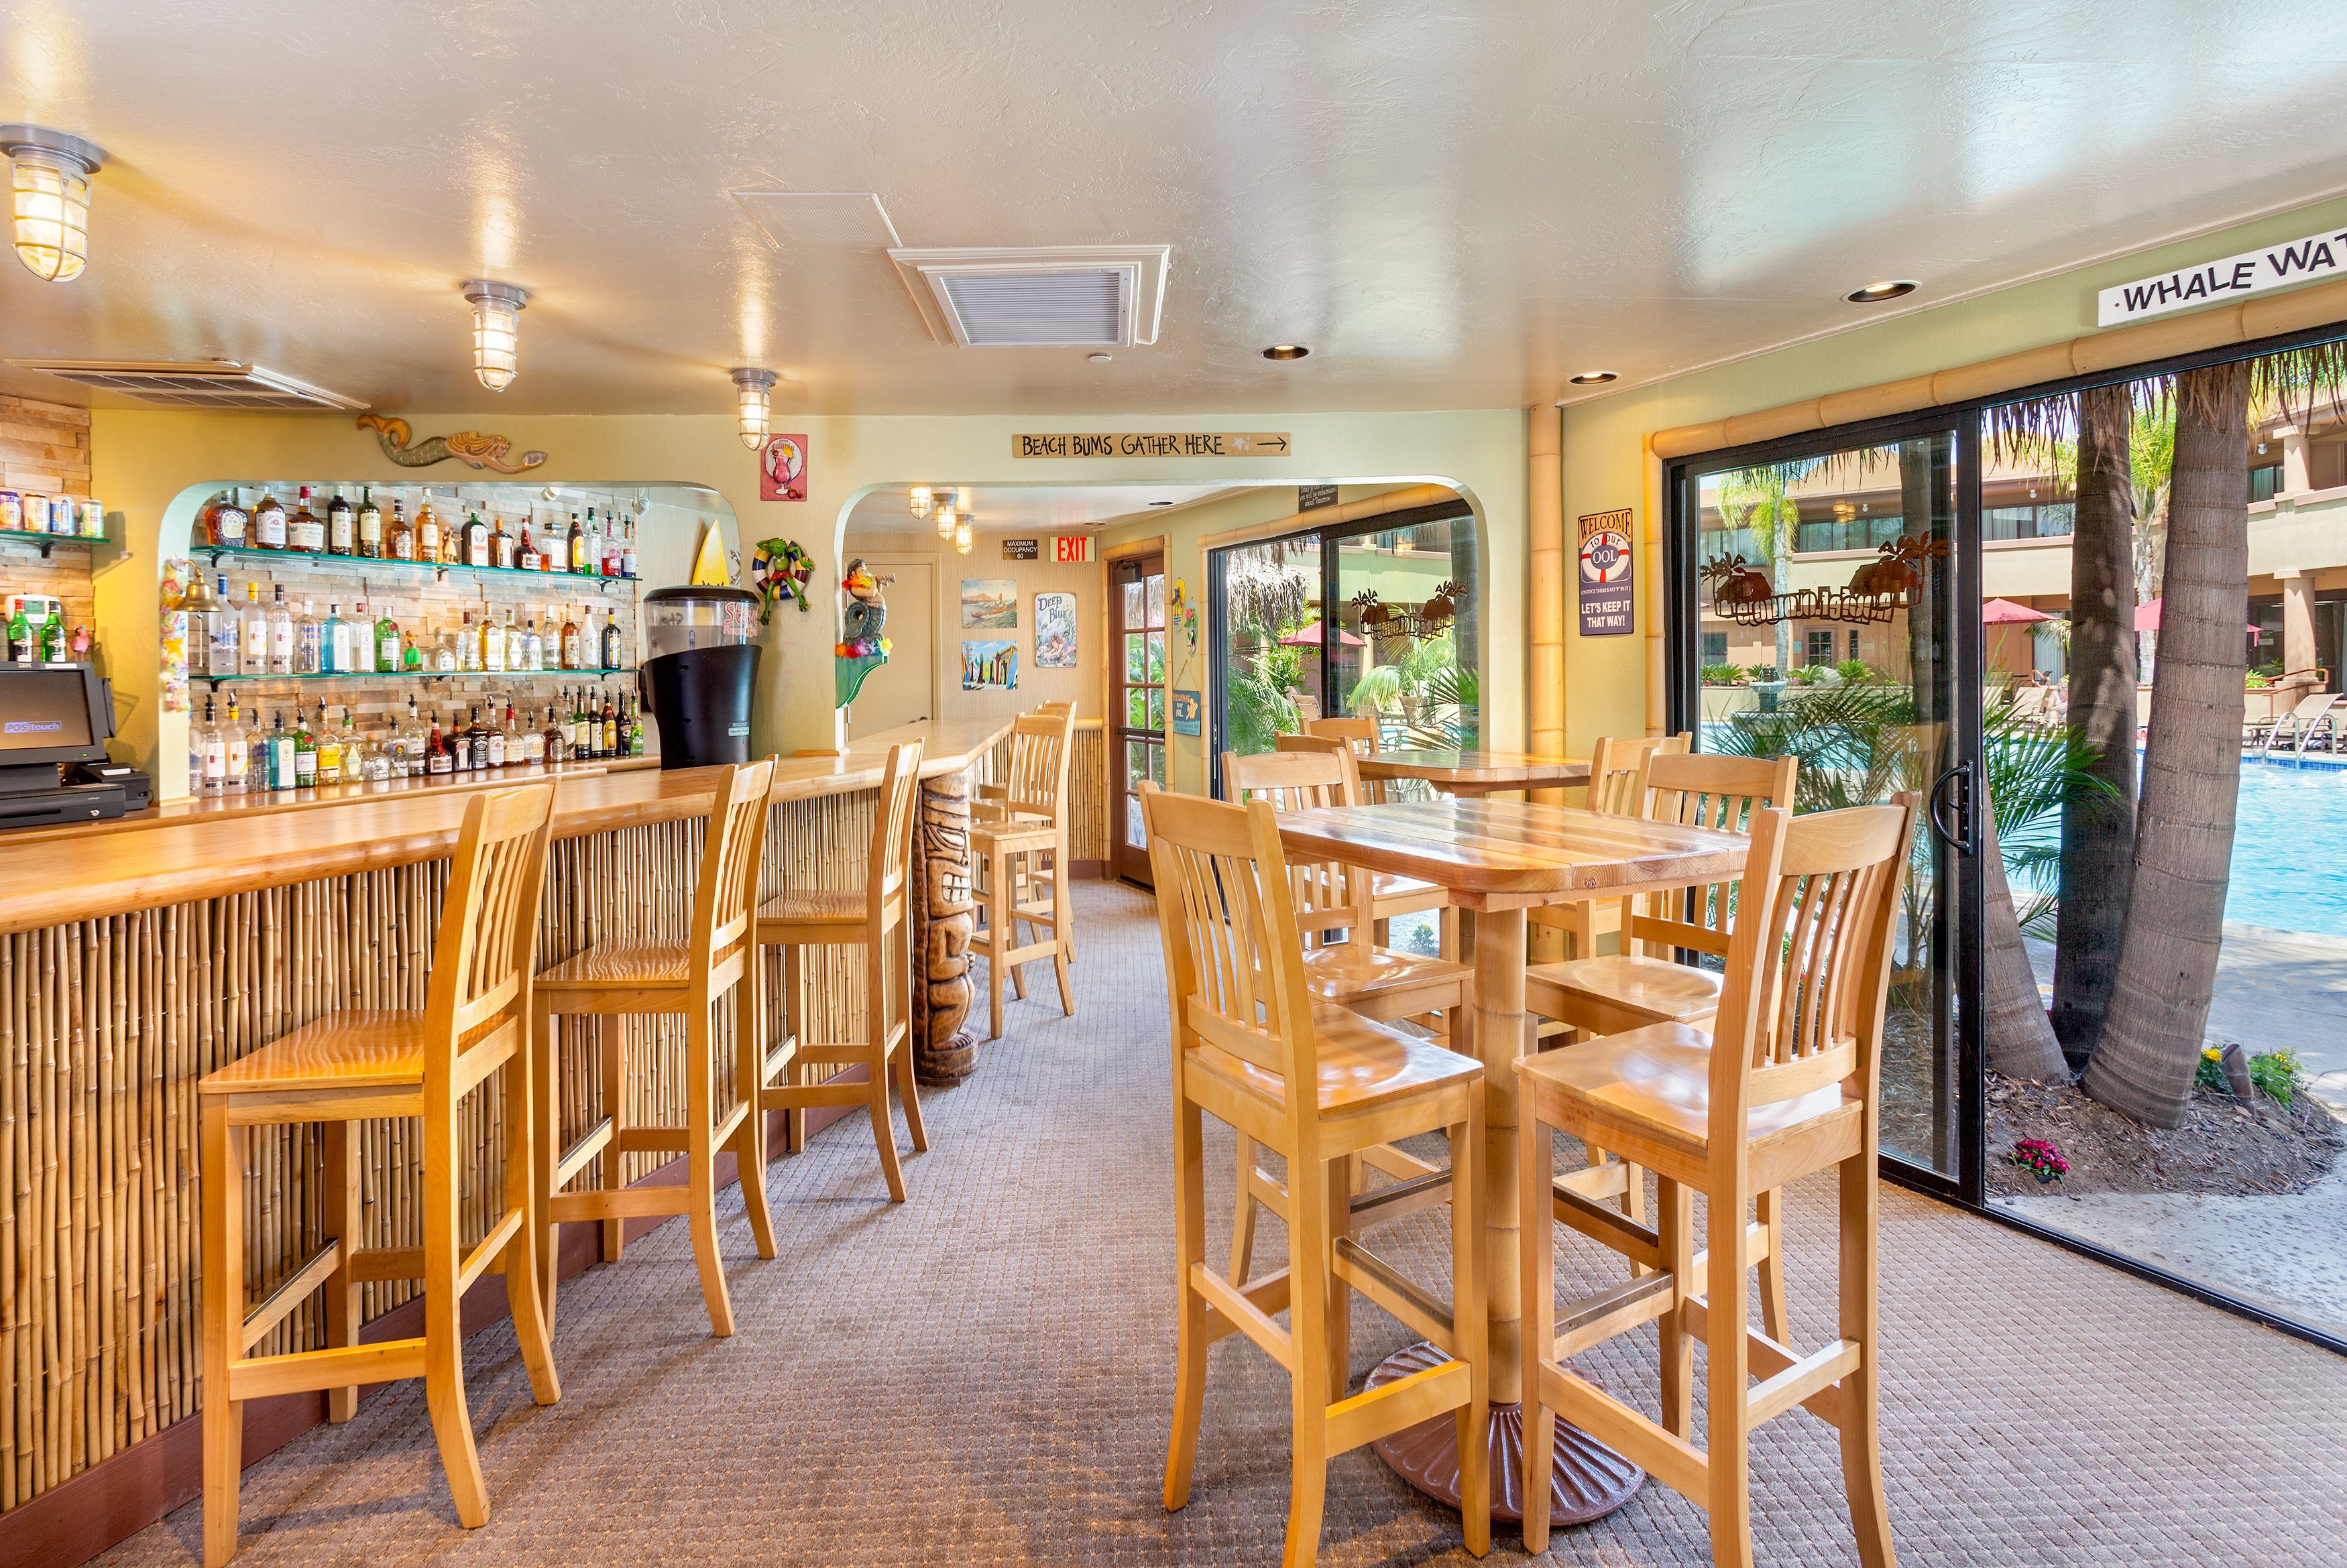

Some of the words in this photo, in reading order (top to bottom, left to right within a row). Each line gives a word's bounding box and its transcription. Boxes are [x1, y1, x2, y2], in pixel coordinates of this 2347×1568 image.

[2123, 261, 2256, 312] WHALE
[1022, 435, 1067, 456] BEACH
[1073, 435, 1113, 455] BUMS
[1121, 434, 1180, 456] GATHER
[1185, 434, 1226, 455] HERE
[1580, 512, 1631, 540] WELCOME
[1590, 538, 1600, 548] to
[1605, 534, 1621, 545] our
[1057, 537, 1087, 562] EXIT
[1593, 549, 1617, 564] OOL
[1581, 602, 1601, 615] LET'S
[1602, 601, 1621, 613] KEEP
[1623, 600, 1631, 611] IT
[1587, 616, 1605, 628] THAT
[1607, 615, 1625, 627] WAY!
[6, 722, 60, 732] POSitouch
